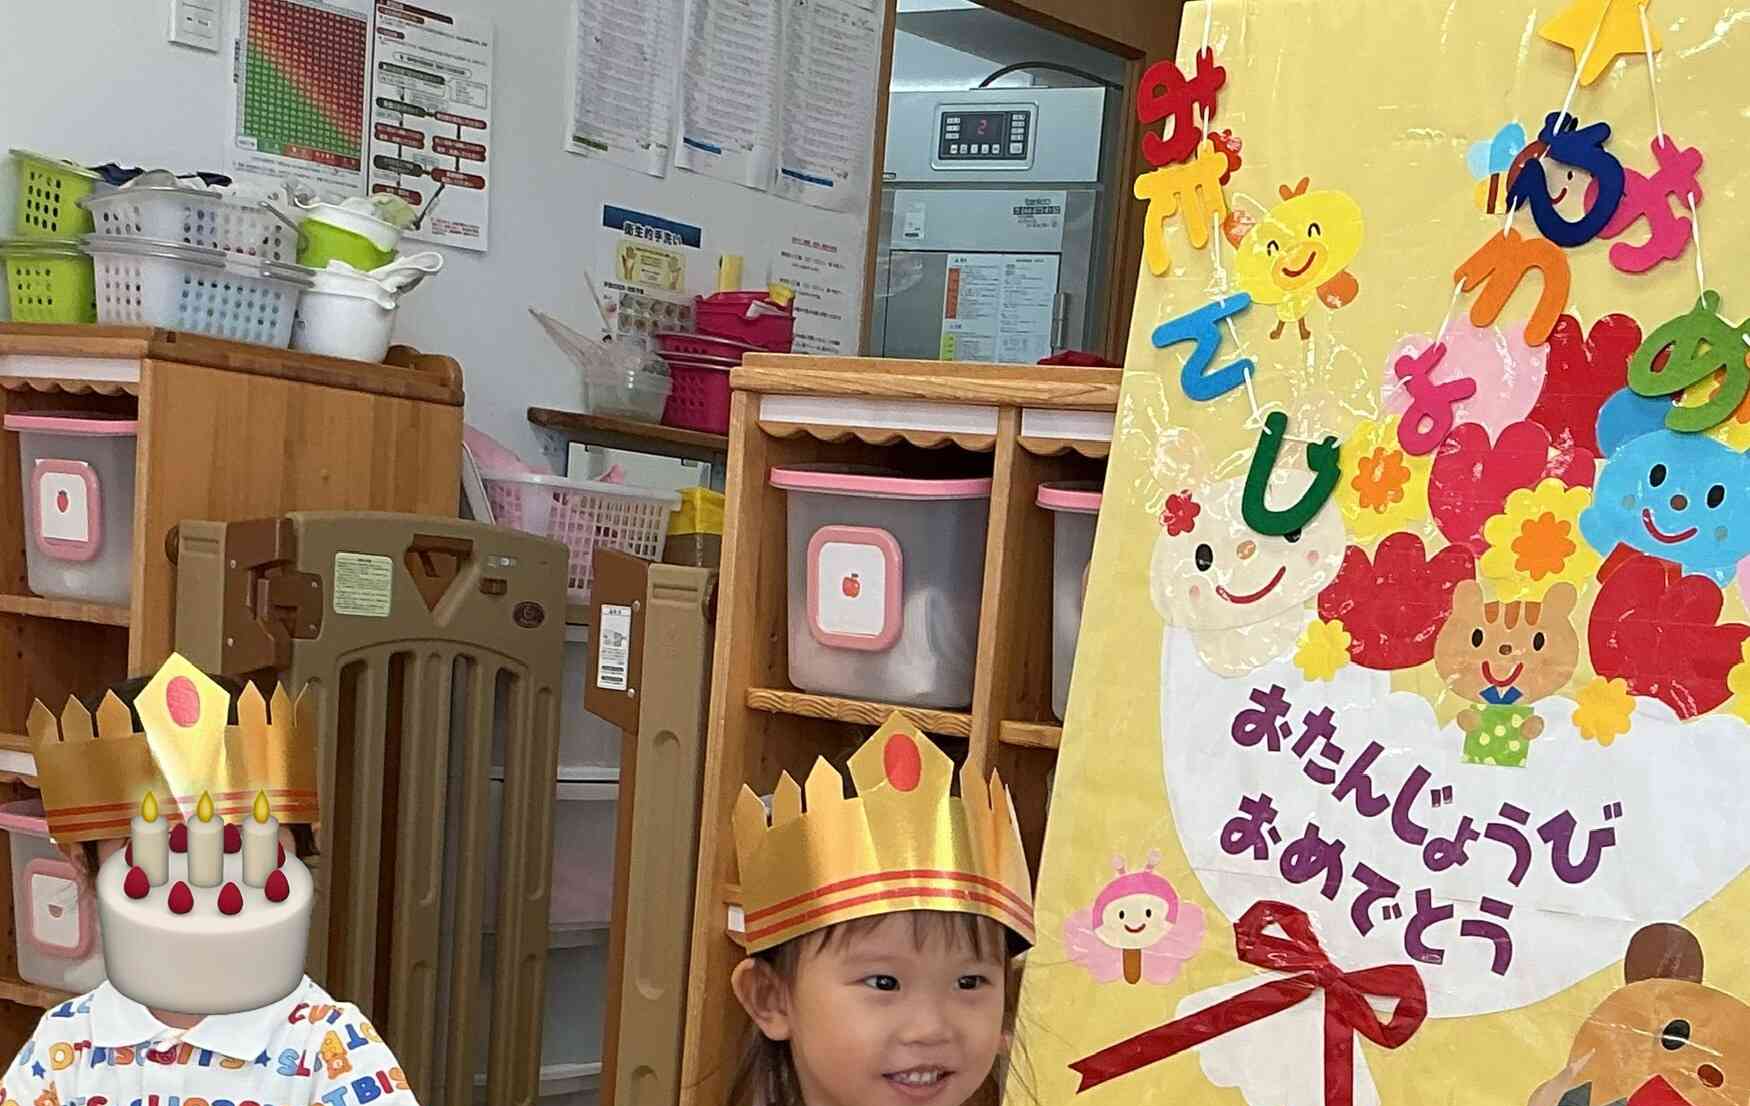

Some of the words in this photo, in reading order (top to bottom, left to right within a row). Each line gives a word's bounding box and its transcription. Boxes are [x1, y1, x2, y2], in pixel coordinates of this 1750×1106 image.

[1231, 684, 1622, 887] おたんじょうび
[1220, 793, 1514, 976] おめでとう
